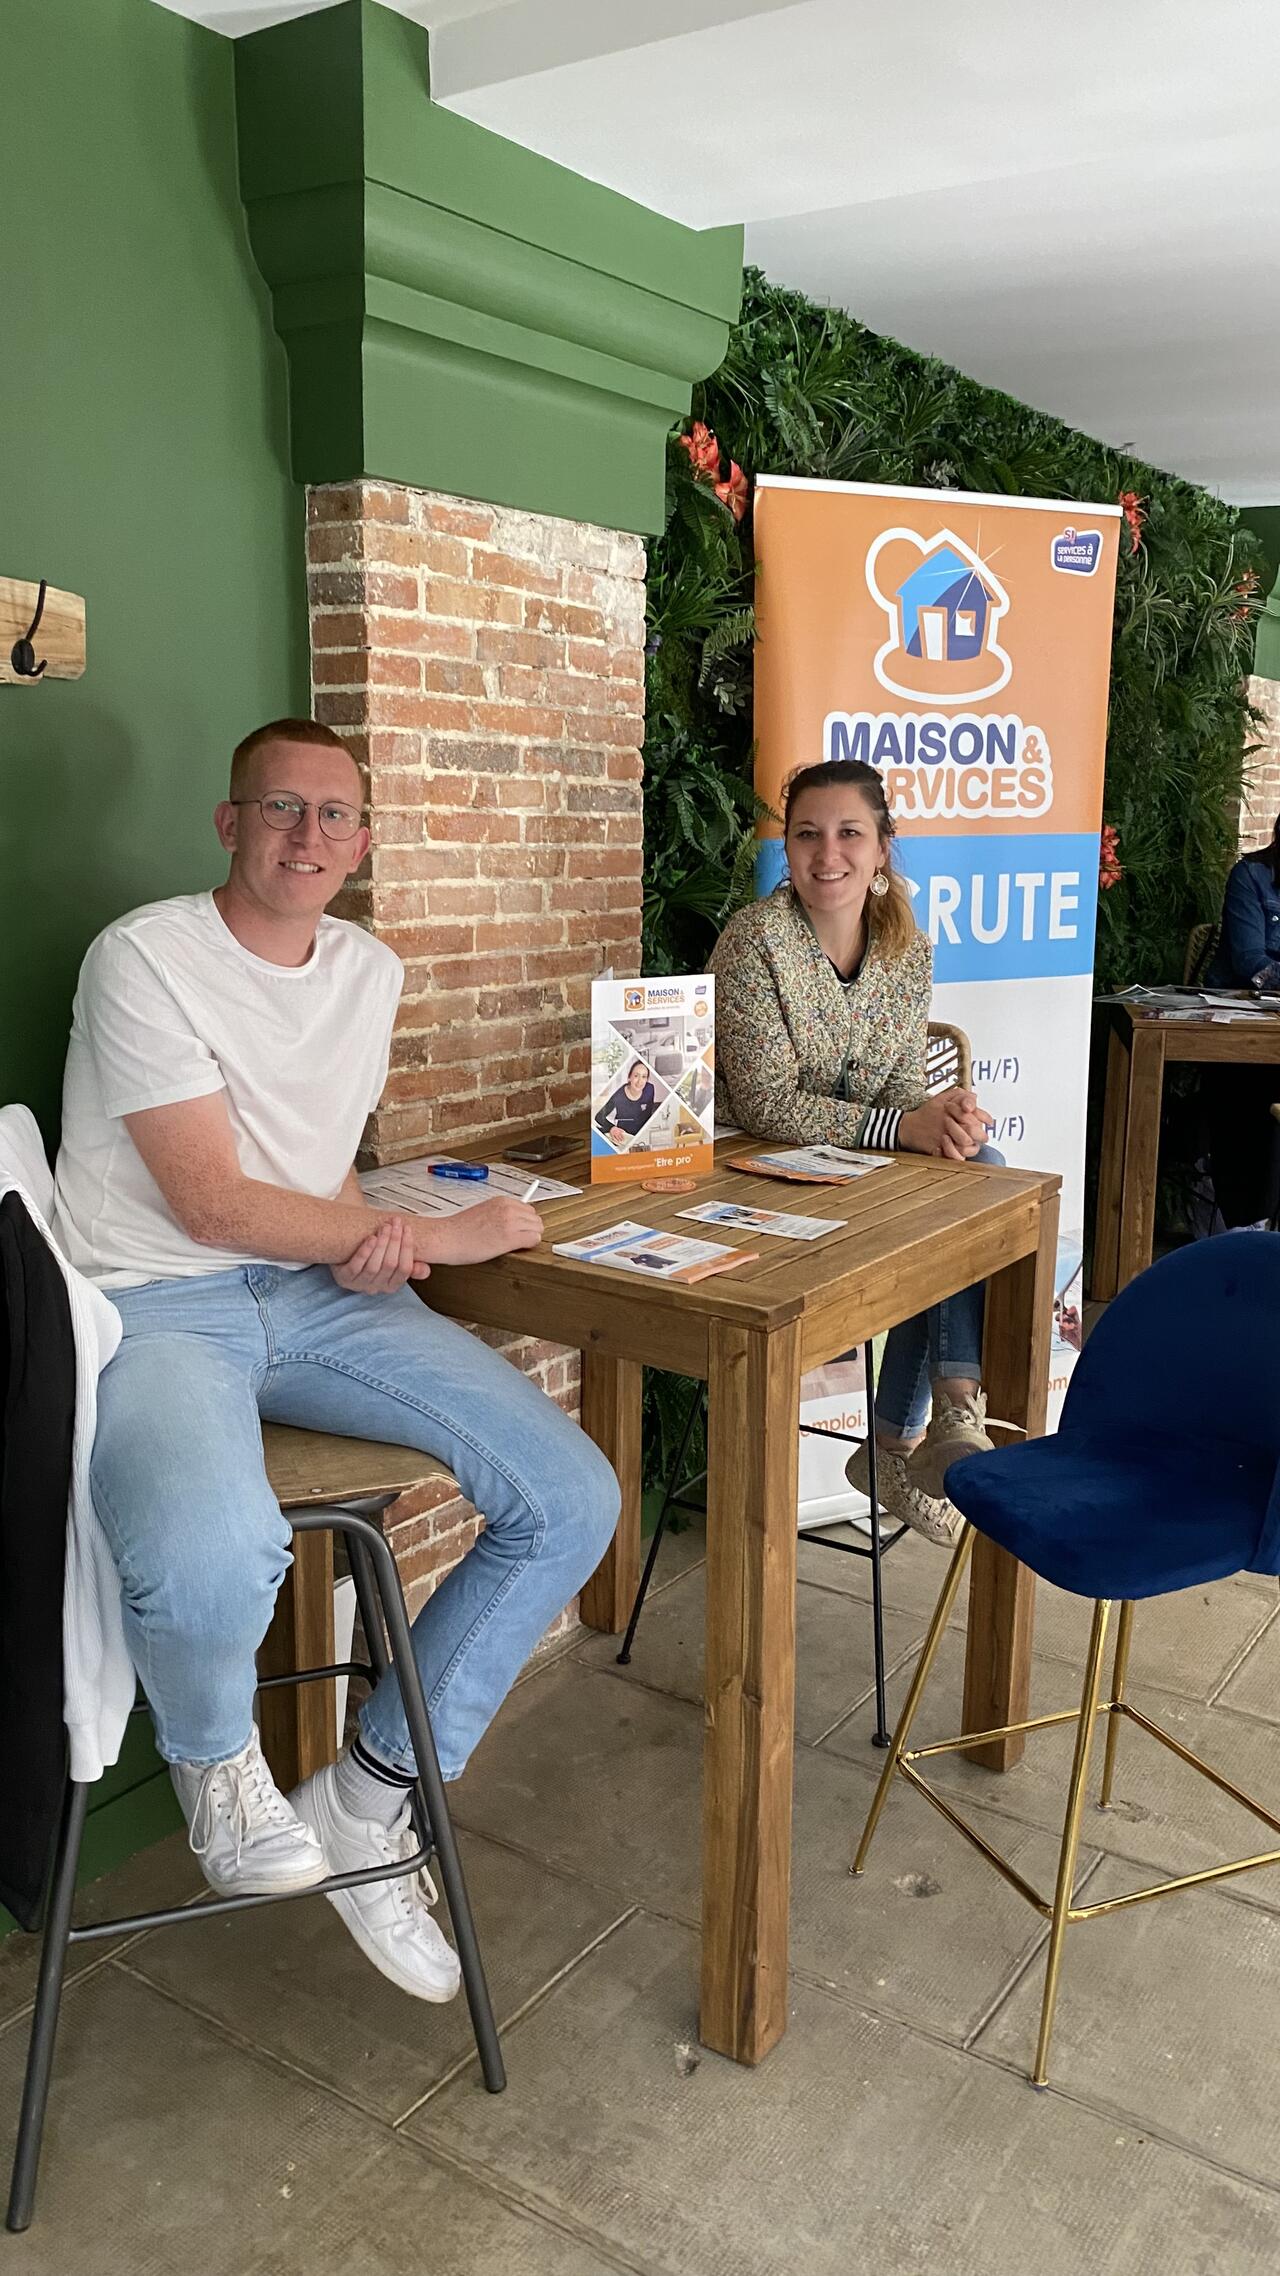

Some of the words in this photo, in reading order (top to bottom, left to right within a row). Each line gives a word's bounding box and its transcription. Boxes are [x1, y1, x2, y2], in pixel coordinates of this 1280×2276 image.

[831, 721, 1016, 766] MAISON
[1022, 734, 1044, 765] &
[876, 767, 1047, 810] RVICES
[903, 871, 1080, 946] RUTE
[647, 988, 680, 998] MAISON
[971, 1057, 1019, 1087] (H/F)
[984, 1115, 1025, 1142] H/F)
[800, 1409, 866, 1438] mploi.
